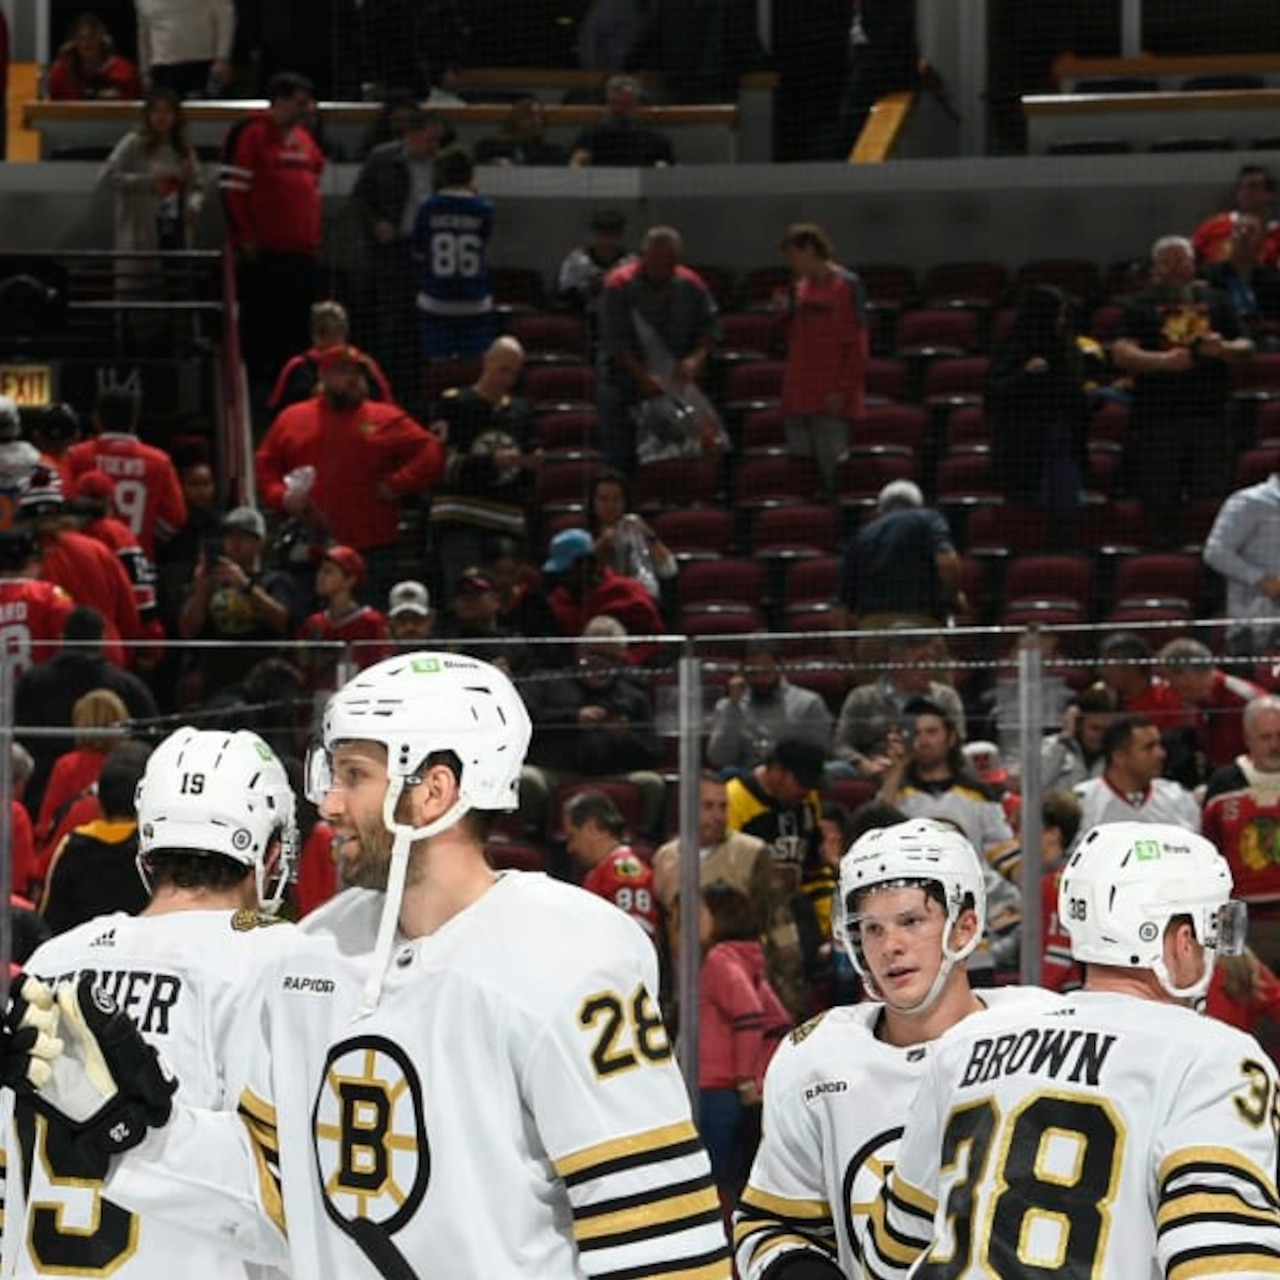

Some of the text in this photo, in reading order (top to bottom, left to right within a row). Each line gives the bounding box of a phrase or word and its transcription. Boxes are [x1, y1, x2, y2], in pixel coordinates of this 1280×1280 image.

[431, 233, 481, 276] 86
[0, 368, 51, 407] EXIT
[180, 773, 206, 794] 19
[616, 888, 651, 912] 88
[578, 982, 670, 1078] 28
[958, 1027, 1118, 1090] BROWN
[336, 1081, 393, 1197] B
